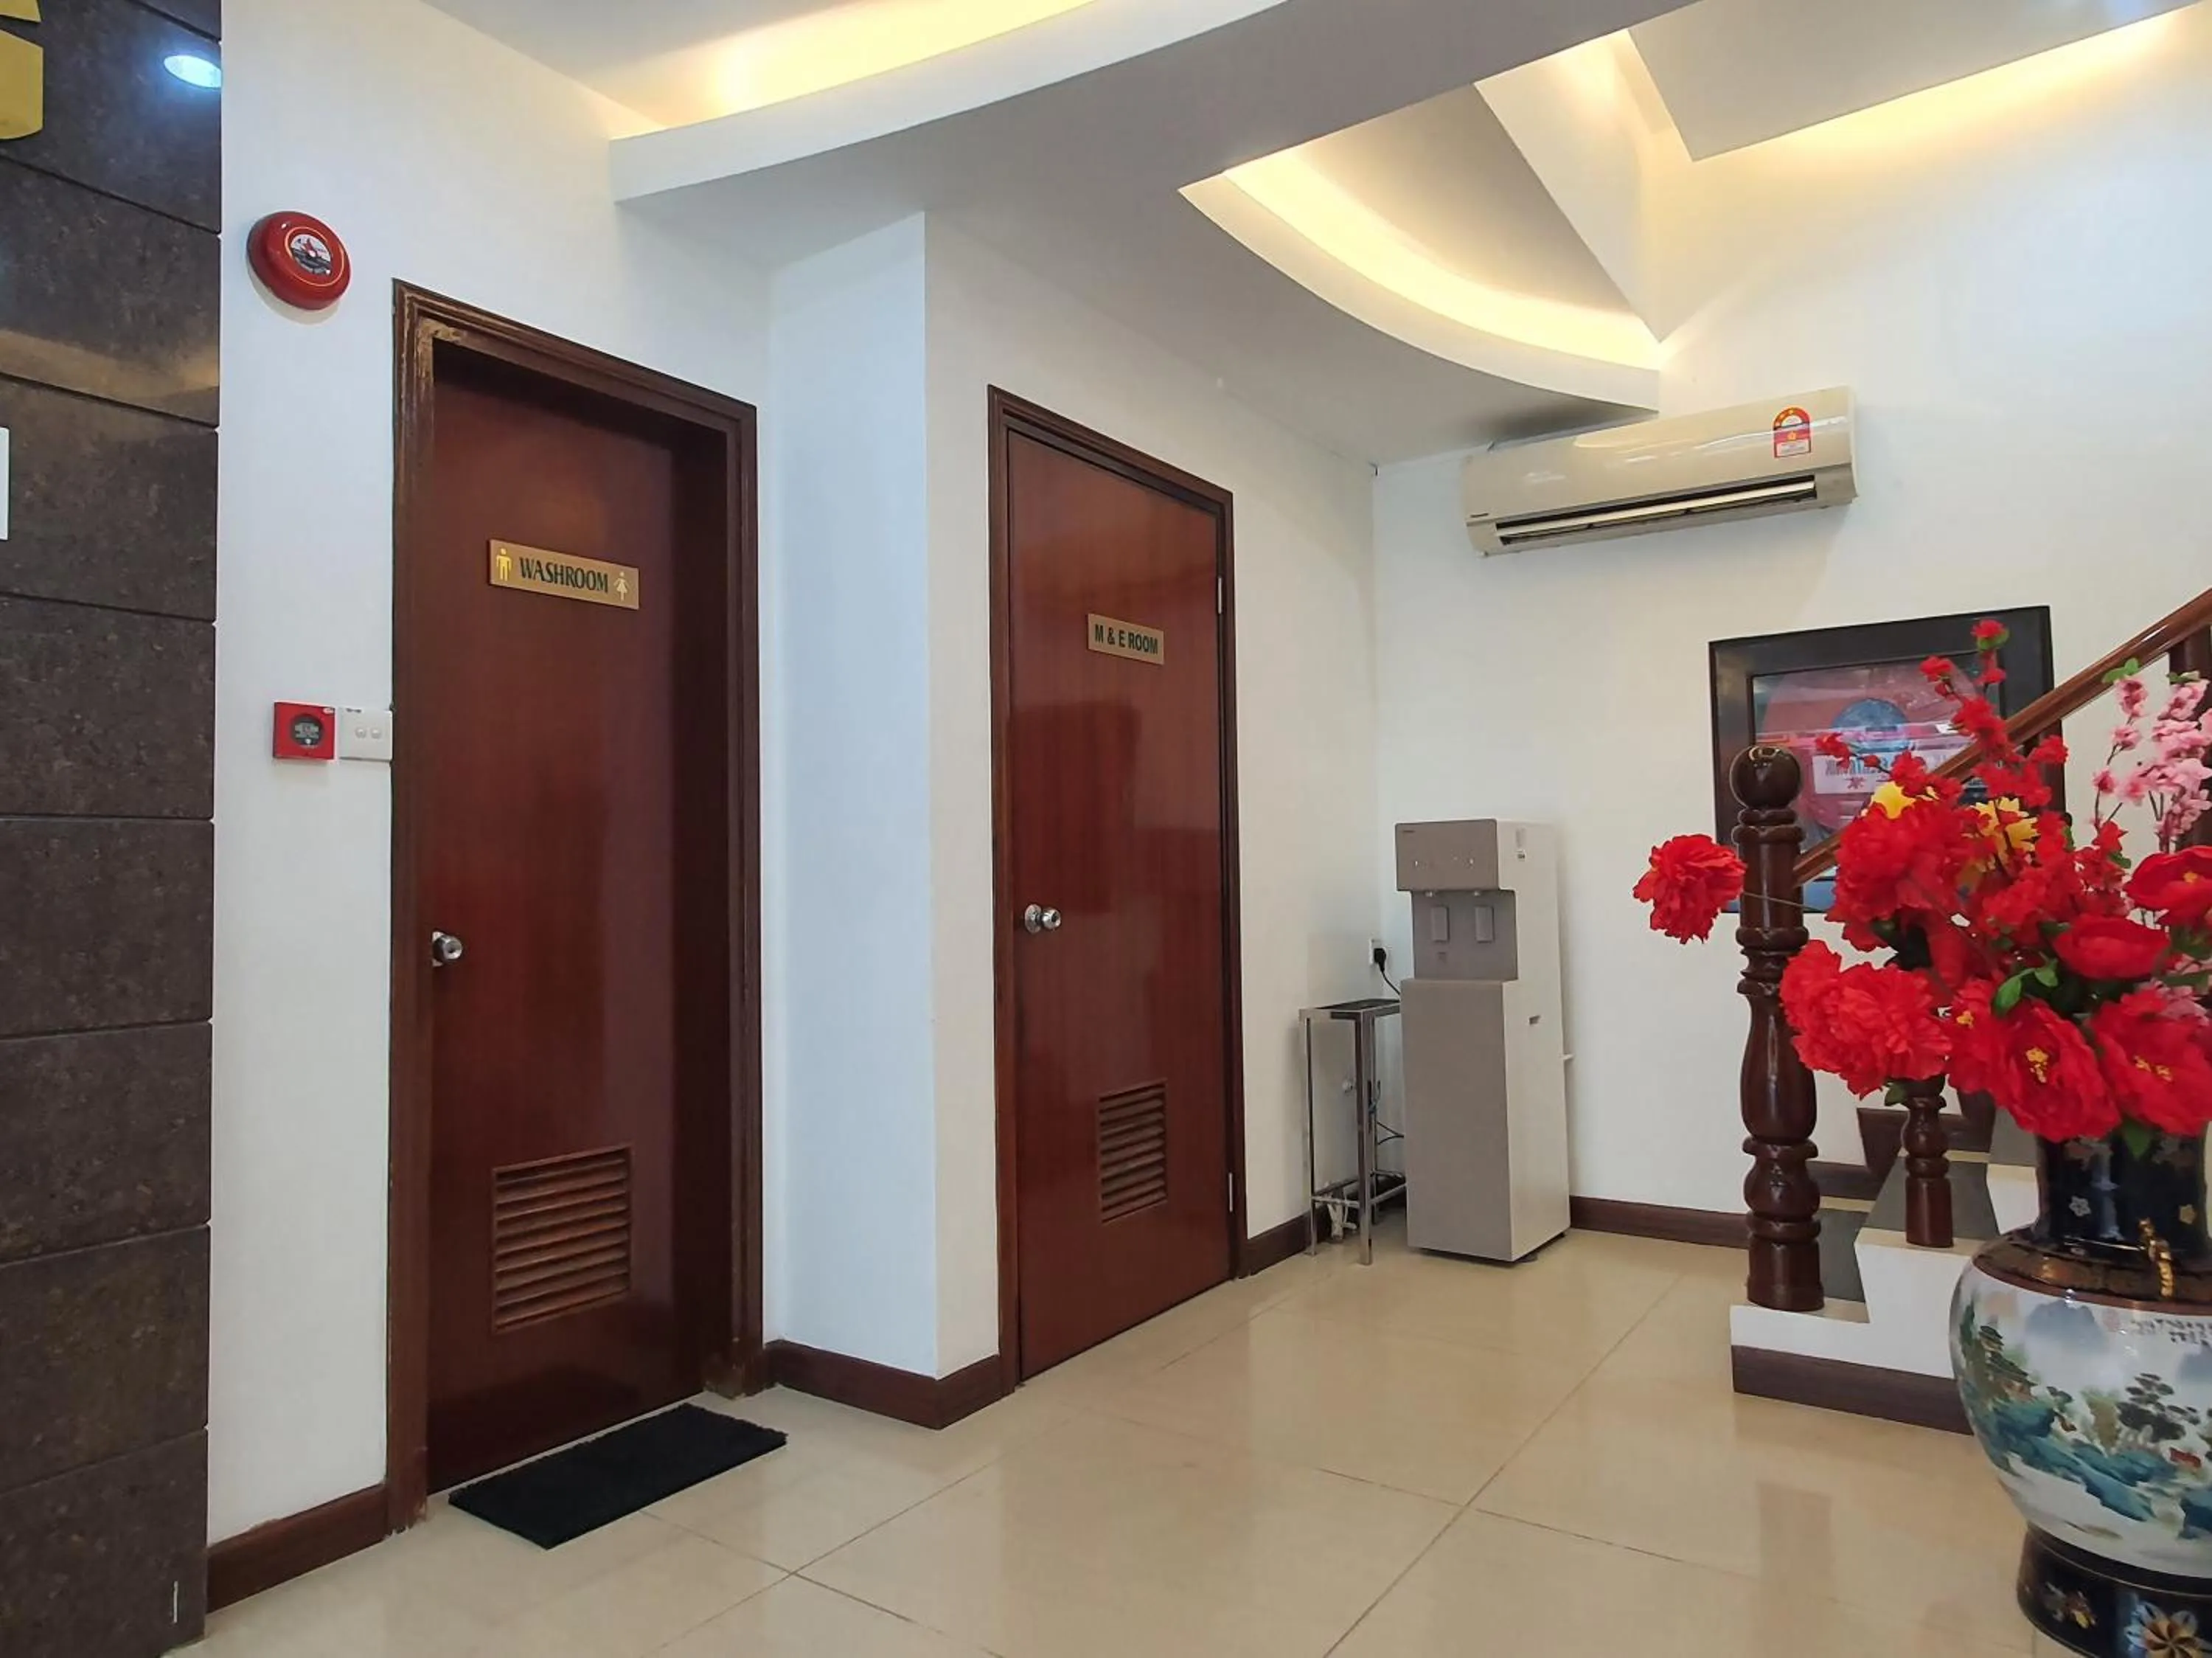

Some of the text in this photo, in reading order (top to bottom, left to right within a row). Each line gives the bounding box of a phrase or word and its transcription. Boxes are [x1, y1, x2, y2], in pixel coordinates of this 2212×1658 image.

[519, 557, 608, 593] WASHROOM
[1095, 624, 1158, 655] M & E ROOM
